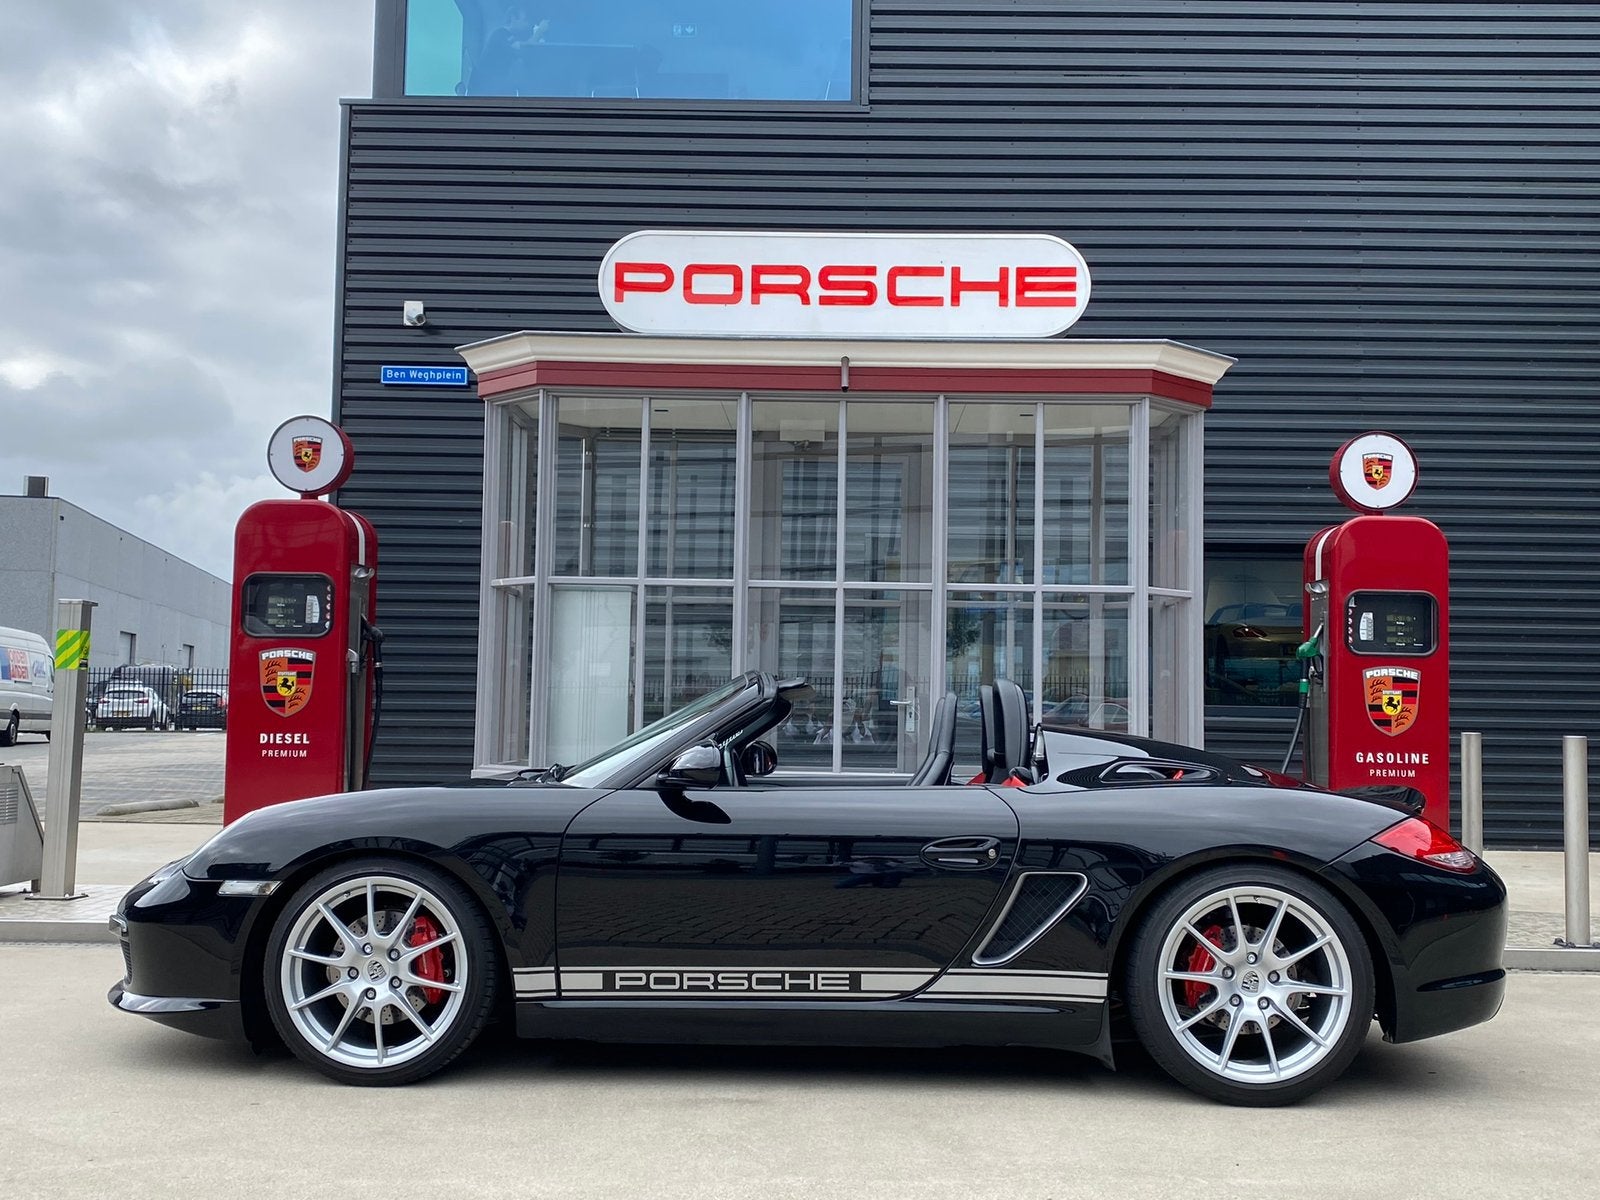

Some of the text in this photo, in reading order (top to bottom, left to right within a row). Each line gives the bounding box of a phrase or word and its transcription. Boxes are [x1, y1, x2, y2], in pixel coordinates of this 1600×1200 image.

[614, 262, 1077, 308] PORSCHE
[386, 369, 462, 382] Ben Weghplein
[261, 649, 314, 661] PORSCHE
[1365, 668, 1419, 680] PORSCHE
[259, 733, 310, 745] DIESEL
[261, 749, 308, 758] PREMIUM
[1355, 751, 1430, 765] GASOLINE
[1369, 768, 1416, 778] PREMIUM
[615, 972, 850, 991] PORSCHE
